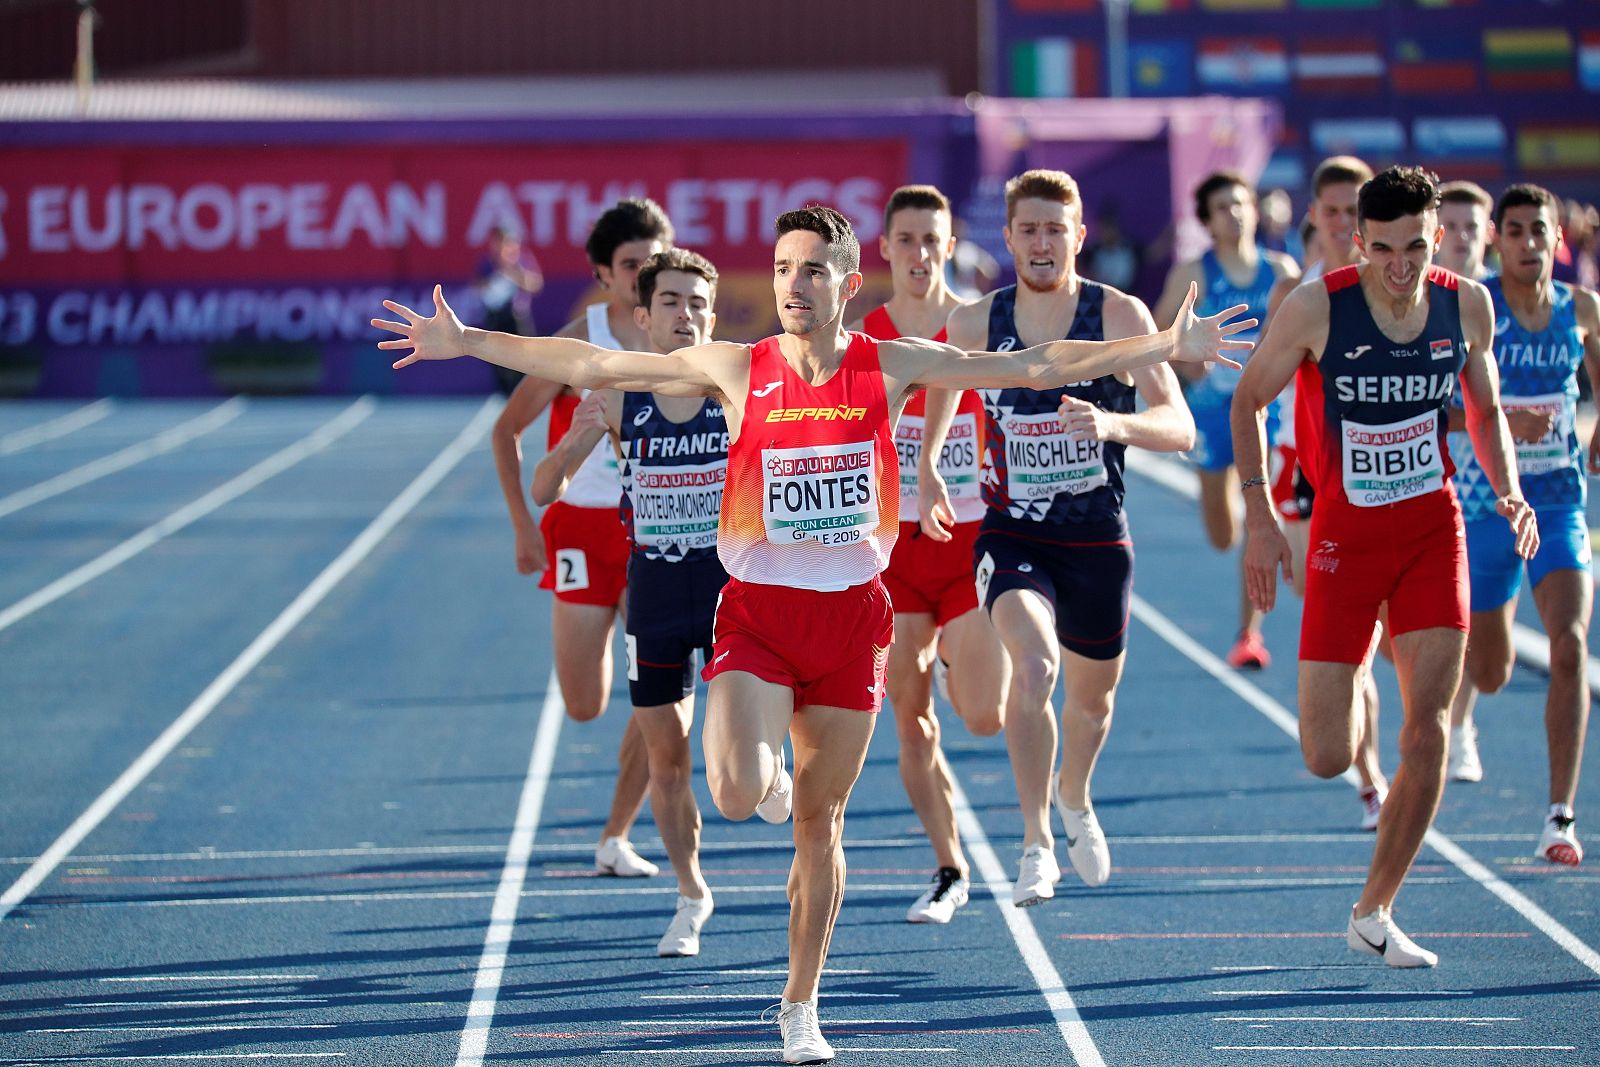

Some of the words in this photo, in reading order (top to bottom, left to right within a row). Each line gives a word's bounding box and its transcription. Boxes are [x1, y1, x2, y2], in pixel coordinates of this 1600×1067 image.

[28, 182, 447, 252] EUROPEAN
[1498, 344, 1568, 367] ITALIA
[1335, 372, 1454, 403] SERBIA
[765, 404, 867, 423] ESPAÑA
[648, 432, 729, 458] FRANCE
[1361, 419, 1433, 446] BAUHAUS
[783, 452, 871, 476] BAUHAUS
[1010, 439, 1099, 468] MISCHLER
[1351, 441, 1433, 476] BIBIC
[649, 469, 725, 488] BAUHAUS
[1031, 475, 1050, 483] RUN
[769, 473, 870, 513] FONTES
[660, 525, 680, 534] RUN
[833, 530, 860, 544] 2019
[561, 558, 577, 584] 2
